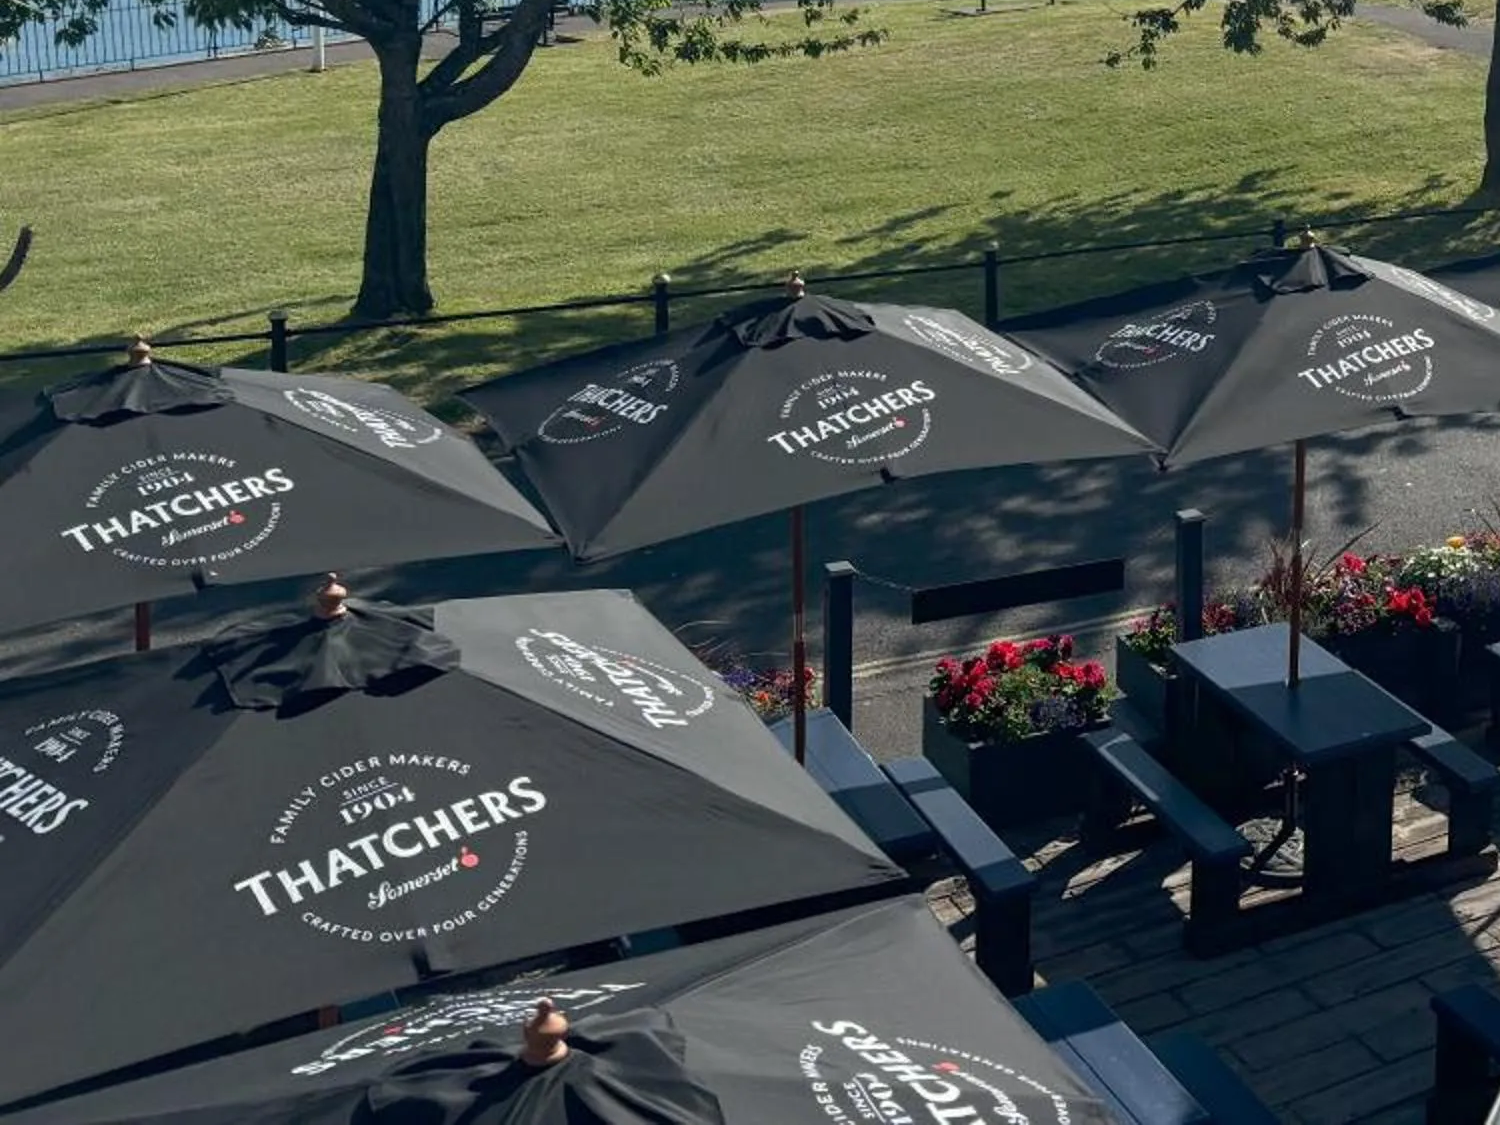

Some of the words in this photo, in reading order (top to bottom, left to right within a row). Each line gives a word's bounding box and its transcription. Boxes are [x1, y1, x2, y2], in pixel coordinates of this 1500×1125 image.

[1297, 328, 1435, 389] THATCHERS
[767, 380, 936, 454] THATCHERS
[121, 452, 167, 475] CIDER
[173, 451, 237, 469] MAKERS
[60, 467, 294, 552] THATCHERS
[112, 547, 167, 567] CRAFTED
[271, 786, 317, 845] FAMILY
[320, 756, 382, 788] CIDER
[389, 753, 471, 775] MAKERS
[339, 785, 416, 825] 1904
[343, 776, 387, 800] SINCE
[233, 776, 547, 916] THATCHERS
[301, 911, 373, 943] CRAFTED
[380, 927, 427, 943] OVER
[433, 910, 477, 935] FOUR
[477, 830, 529, 912] GENERATIONS
[367, 856, 458, 910] Somerset
[811, 1020, 987, 1125] TCHERS
